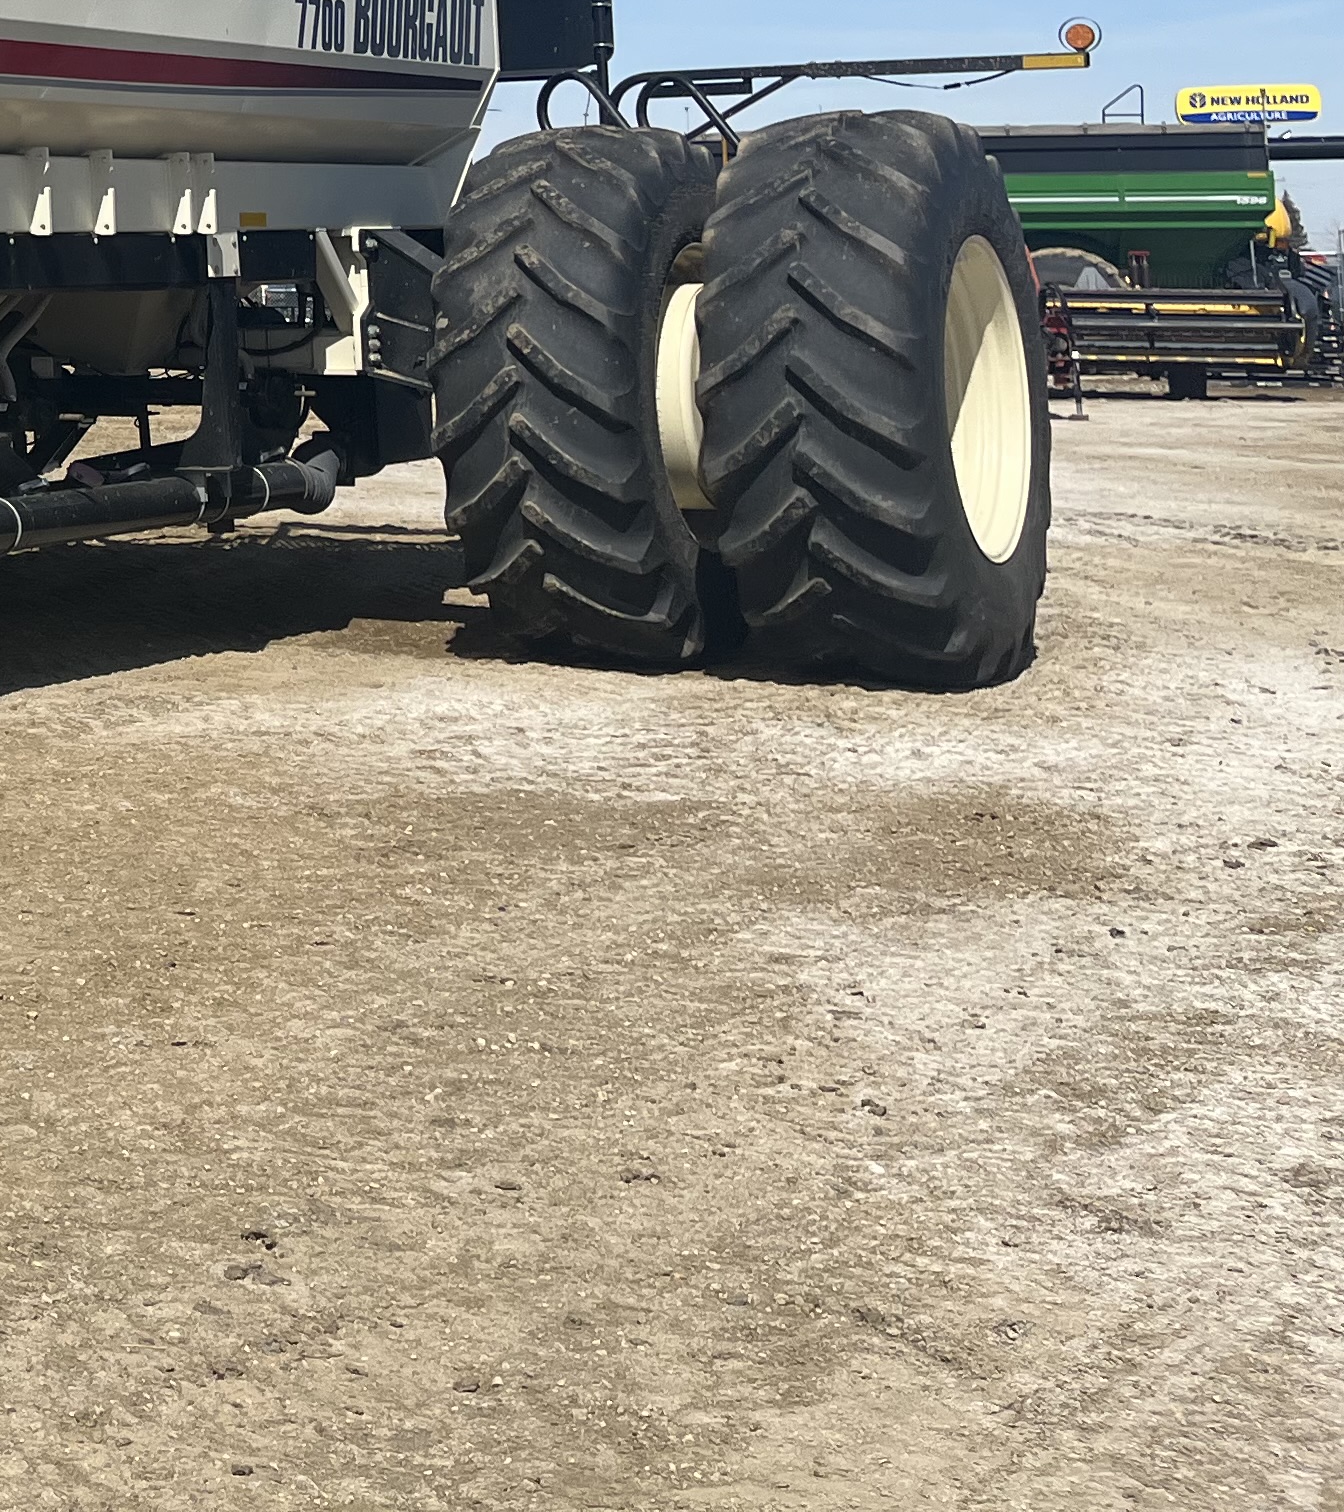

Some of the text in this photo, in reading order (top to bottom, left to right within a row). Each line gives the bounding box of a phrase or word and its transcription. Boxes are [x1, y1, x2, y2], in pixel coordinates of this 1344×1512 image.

[1210, 94, 1310, 107] NEW HOLLAND
[1210, 111, 1288, 122] AGRICULTURE
